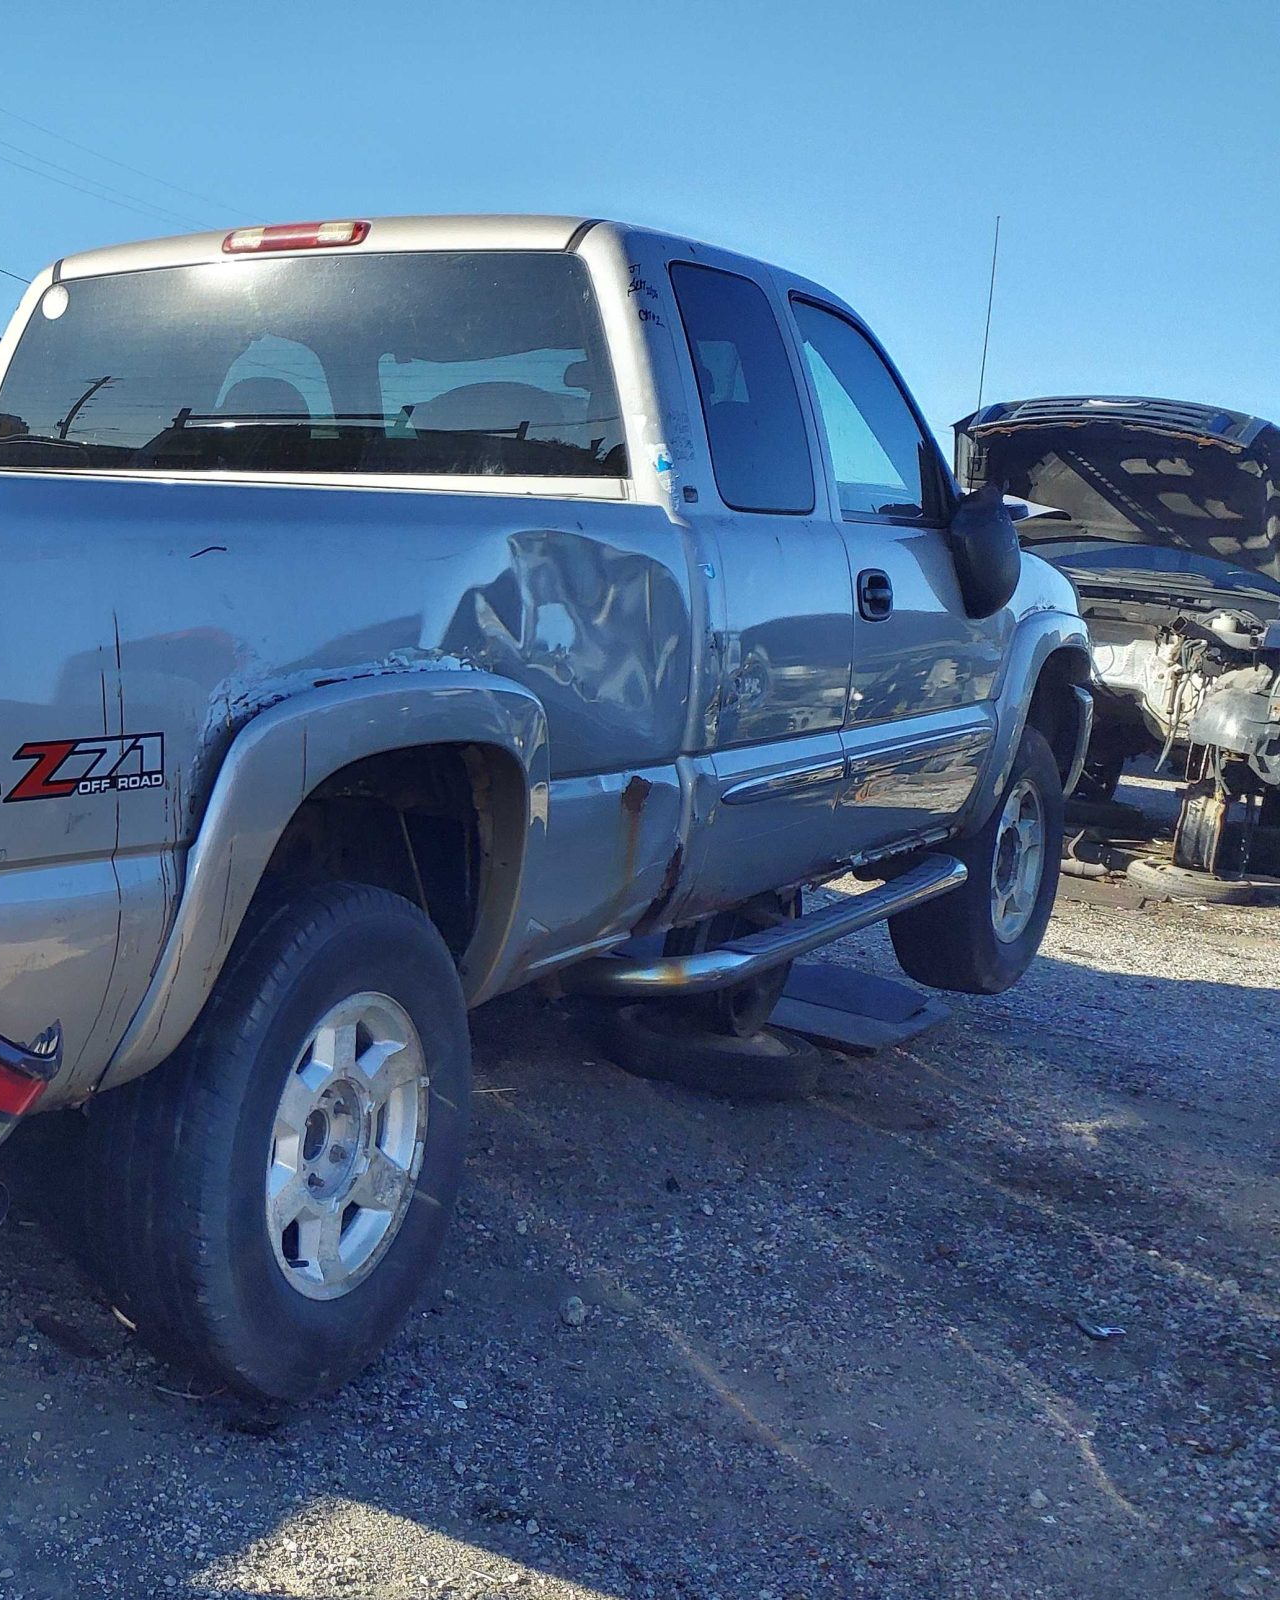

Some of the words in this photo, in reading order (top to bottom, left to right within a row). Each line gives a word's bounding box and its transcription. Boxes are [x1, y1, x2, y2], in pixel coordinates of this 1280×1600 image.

[3, 732, 164, 803] Z71
[78, 778, 110, 795] OFF
[118, 774, 163, 790] ROAD
